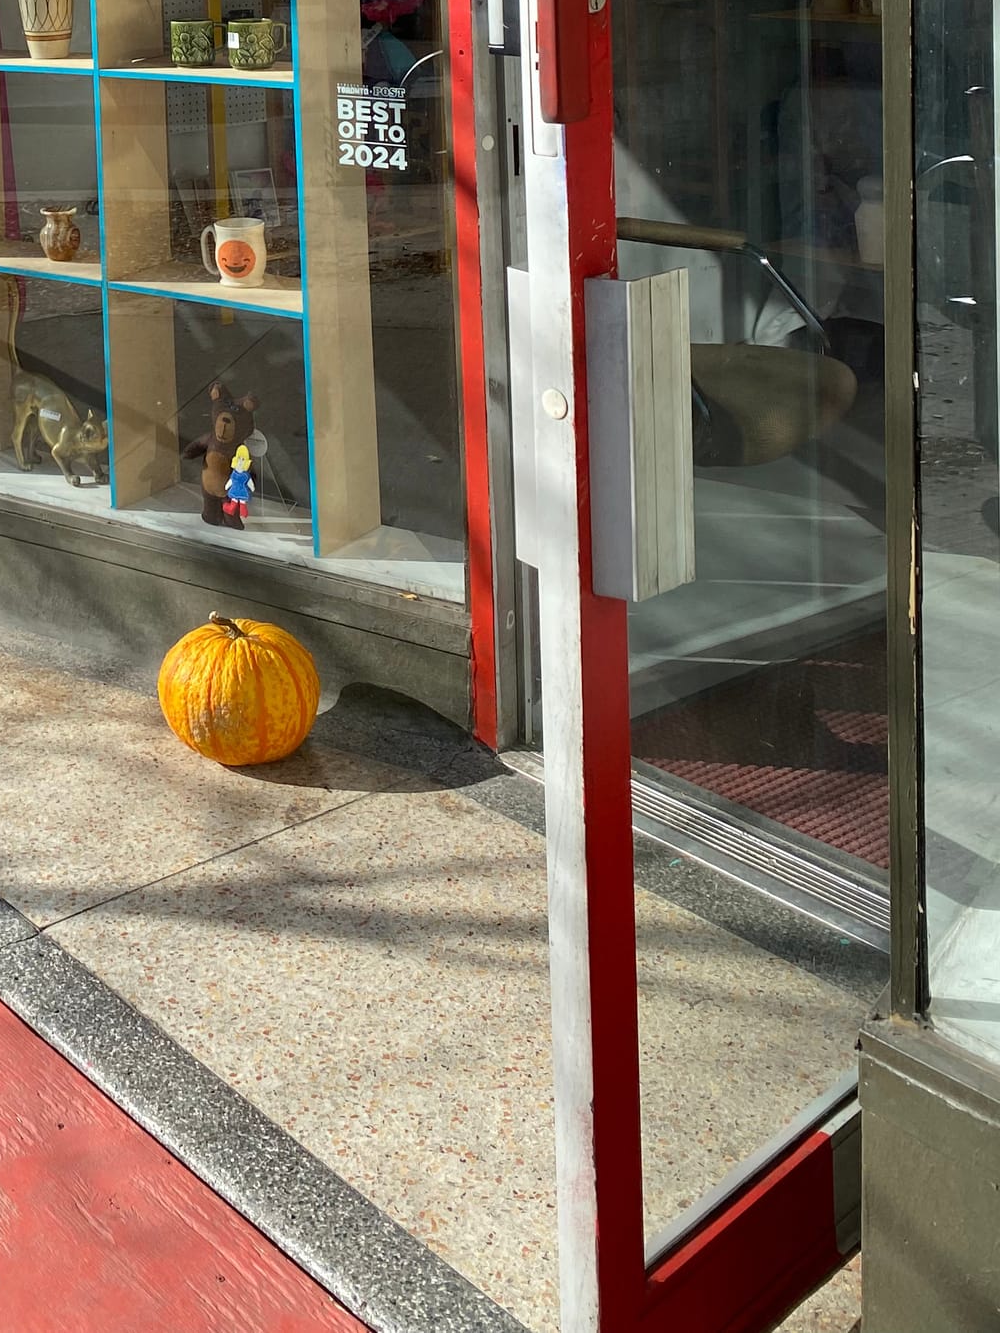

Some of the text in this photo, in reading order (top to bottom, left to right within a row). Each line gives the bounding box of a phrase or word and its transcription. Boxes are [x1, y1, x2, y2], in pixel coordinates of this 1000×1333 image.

[337, 87, 406, 98] TORONTO POST
[337, 98, 407, 124] BEST
[338, 121, 368, 141] OF
[338, 143, 408, 170] 2024
